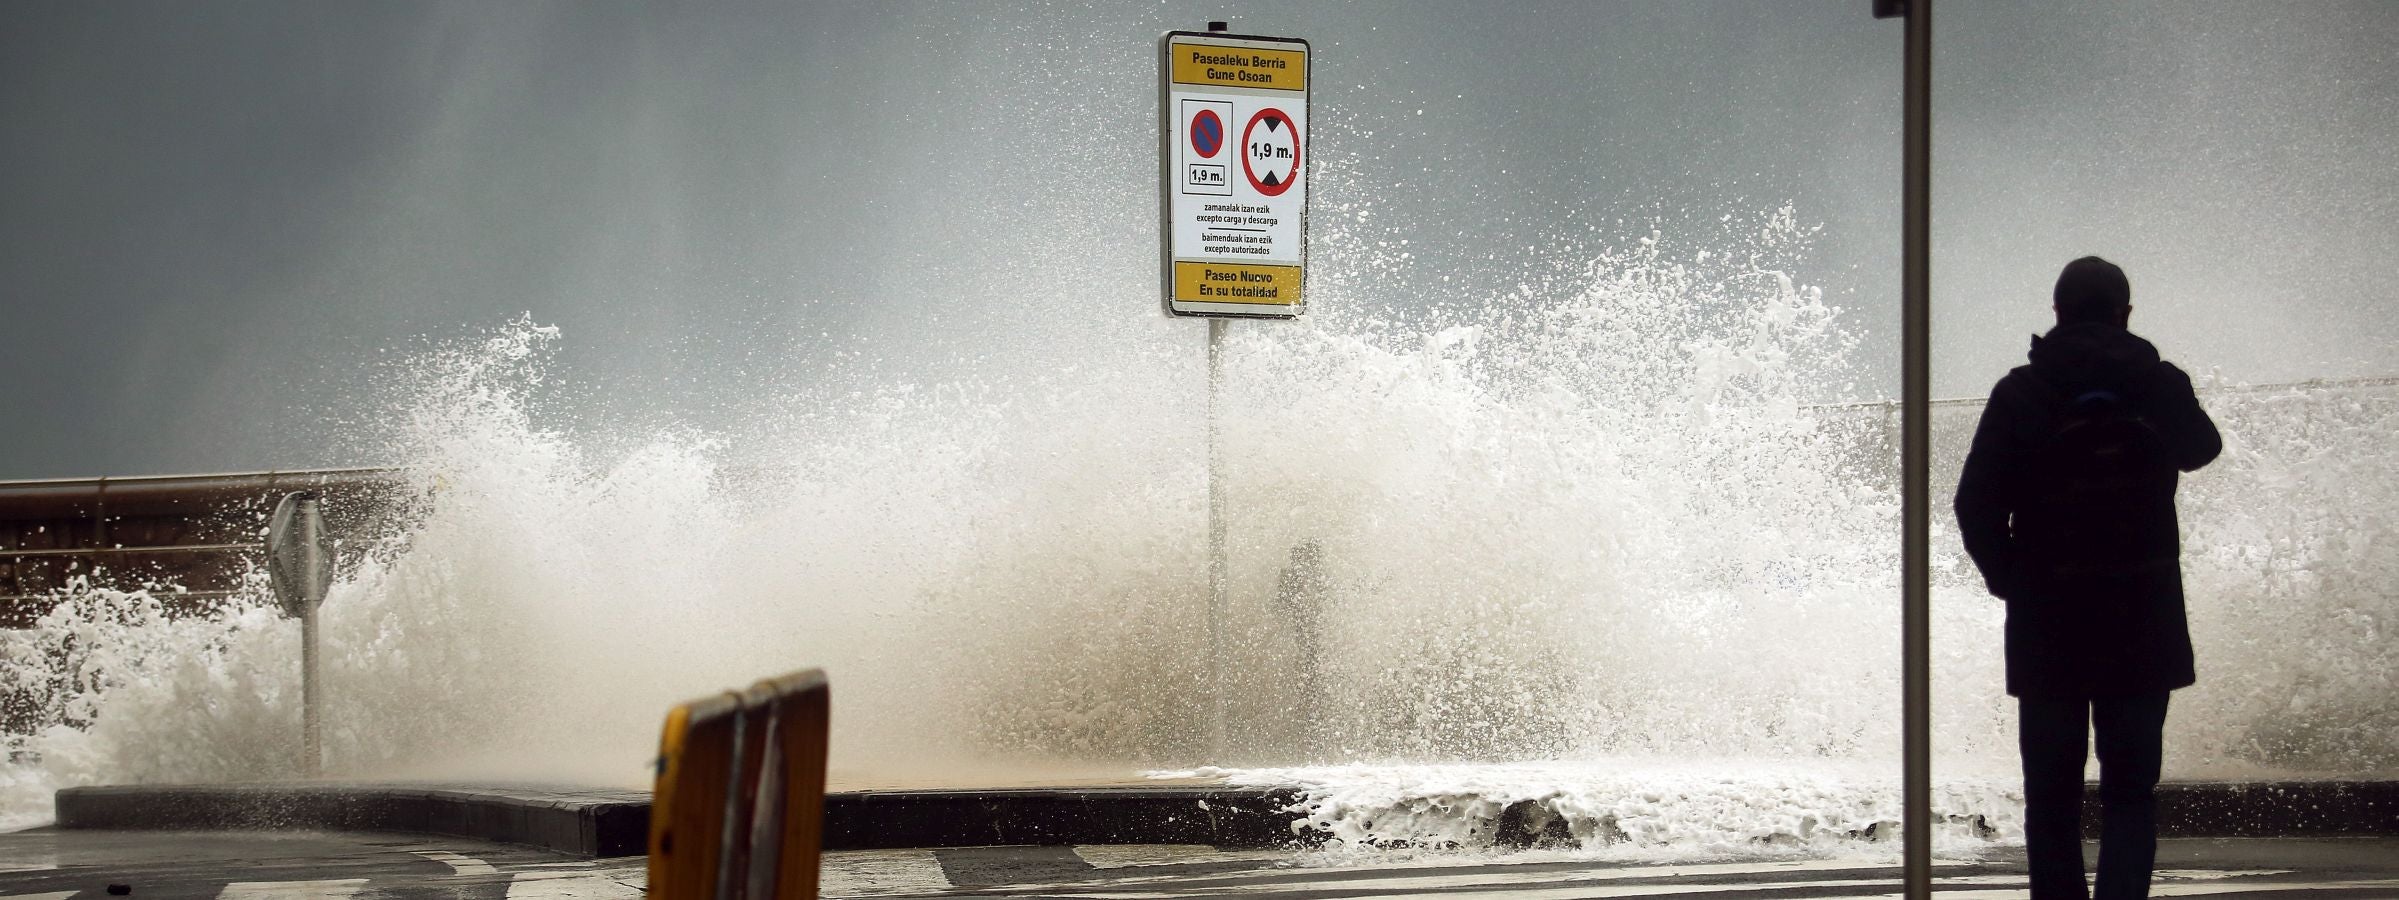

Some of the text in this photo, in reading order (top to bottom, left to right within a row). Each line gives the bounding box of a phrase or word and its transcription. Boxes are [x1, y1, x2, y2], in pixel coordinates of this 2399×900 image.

[1193, 52, 1286, 69] Pasealeku Berria
[1207, 68, 1272, 83] Gune Osoan
[1251, 142, 1293, 160] 1,9 m.
[1191, 169, 1223, 182] 1,9 m.
[1241, 205, 1255, 213] izan
[1256, 205, 1270, 214] ezik
[1196, 215, 1278, 226] excepto carga y descarga
[1202, 233, 1273, 244] baimenduak izan ezik
[1204, 246, 1270, 255] excepto autorizados
[1205, 269, 1273, 283] Paseo Nuevo
[1200, 284, 1278, 298] En su totalidad
